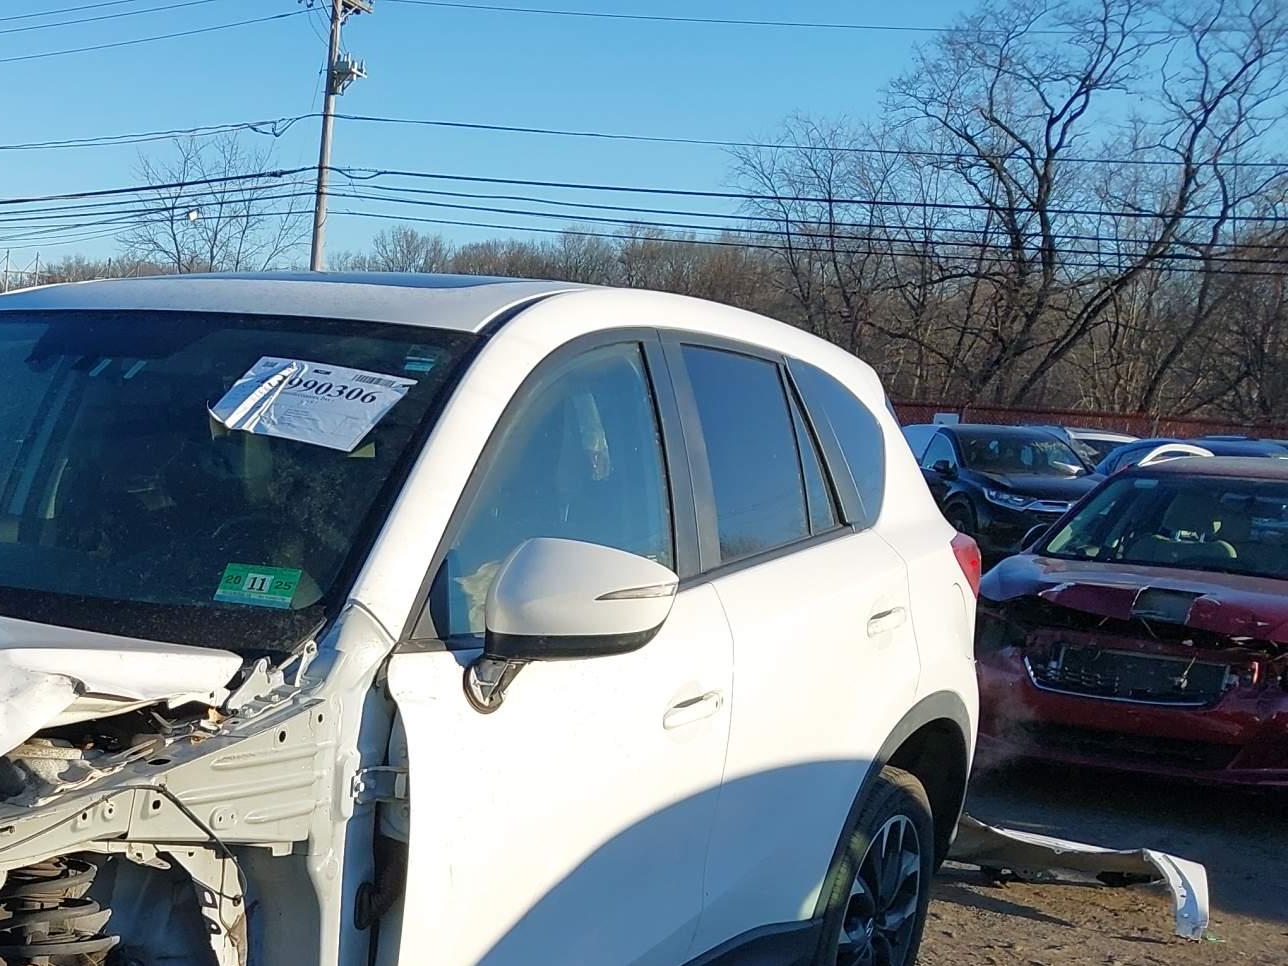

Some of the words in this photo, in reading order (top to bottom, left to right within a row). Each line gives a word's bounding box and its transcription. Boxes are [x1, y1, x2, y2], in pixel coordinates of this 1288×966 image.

[225, 574, 242, 585] 20
[247, 576, 267, 592] 11
[274, 580, 293, 591] 25
